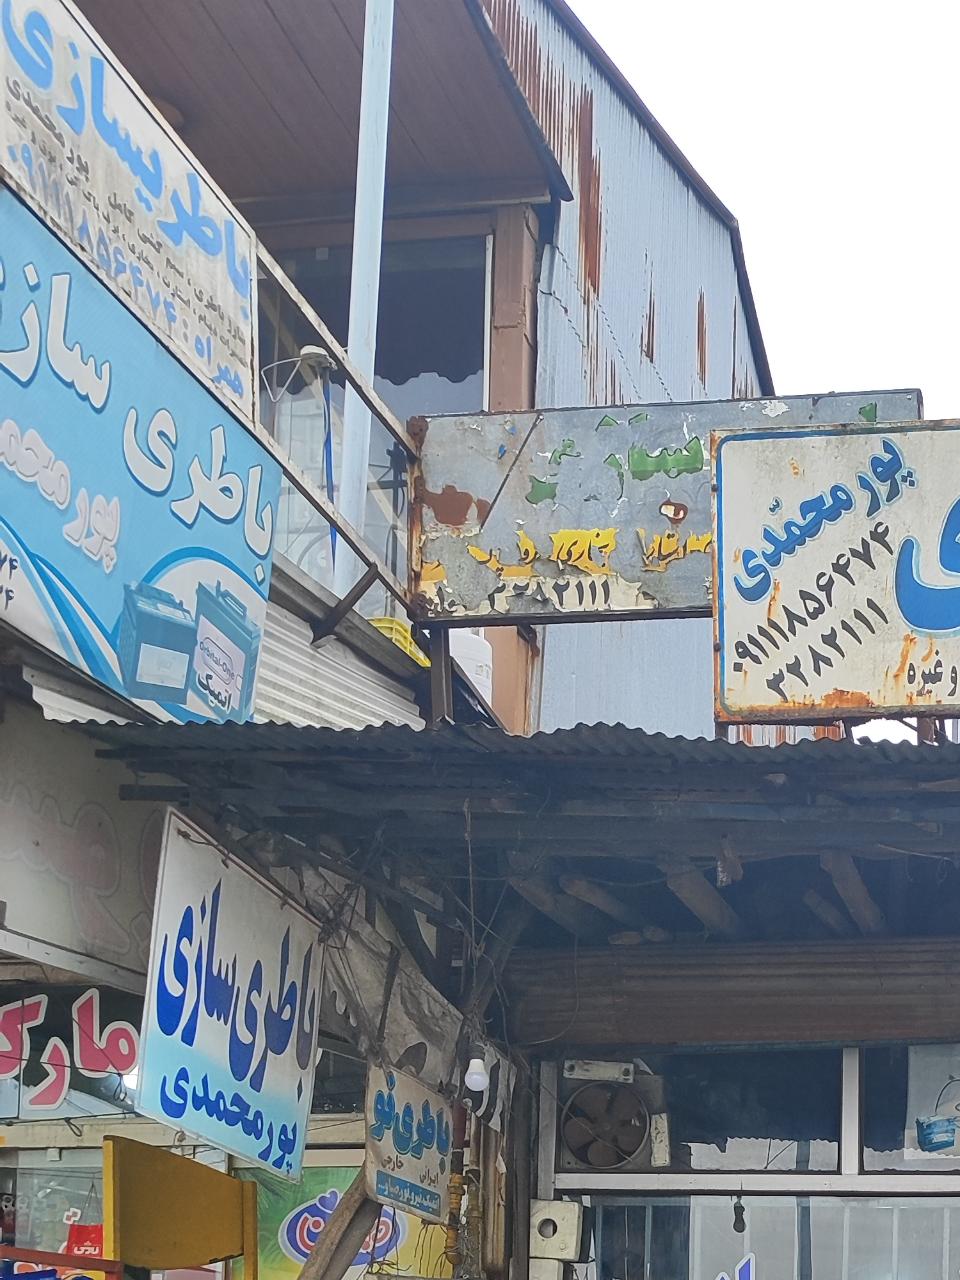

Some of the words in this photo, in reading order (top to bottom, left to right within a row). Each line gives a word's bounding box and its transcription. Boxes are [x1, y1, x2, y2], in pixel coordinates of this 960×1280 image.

[0, 255, 111, 410] ساز
[124, 407, 272, 584] باطری
[733, 521, 894, 672] ۰۹۱۱۱۸۵۶۴۷۴
[907, 649, 944, 697] غیره
[947, 665, 958, 697] و
[156, 877, 236, 1048] سازی
[228, 924, 318, 1103] باطری
[392, 1099, 450, 1175] باطری
